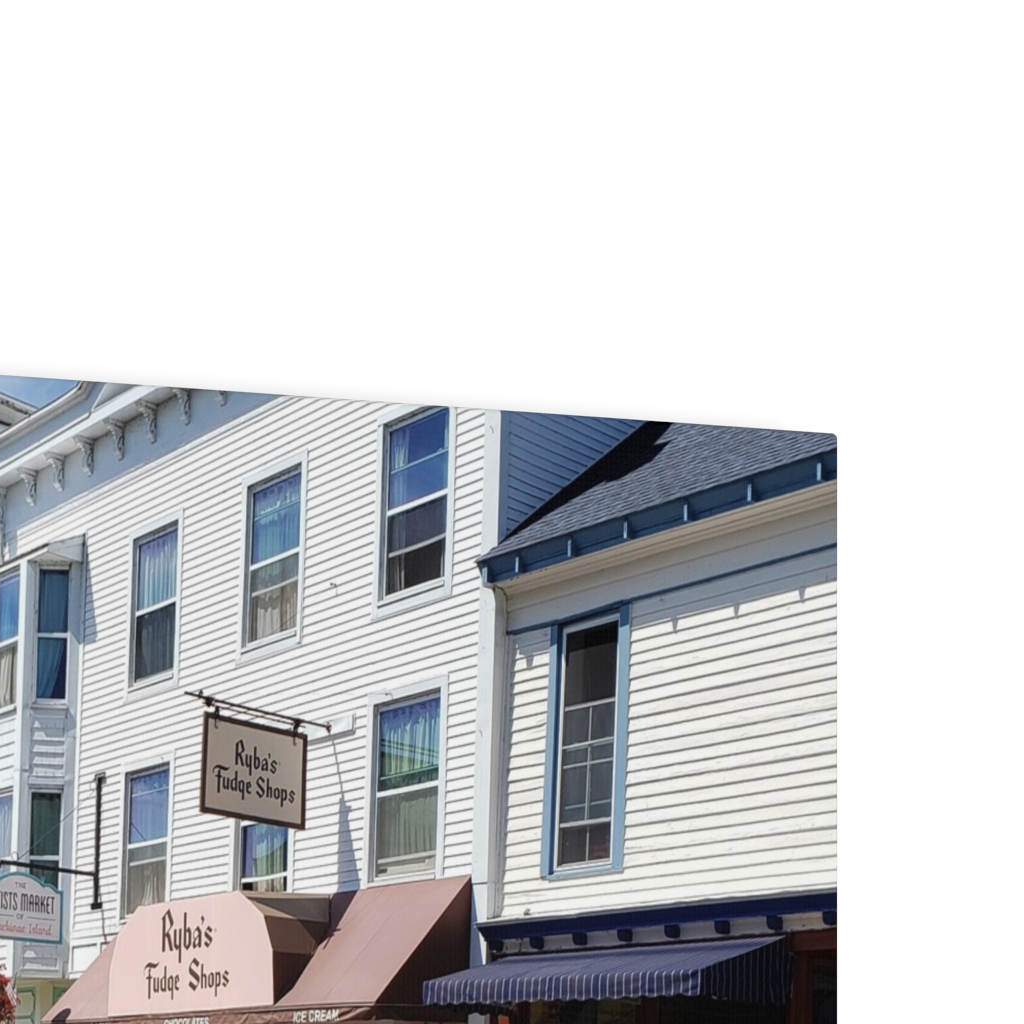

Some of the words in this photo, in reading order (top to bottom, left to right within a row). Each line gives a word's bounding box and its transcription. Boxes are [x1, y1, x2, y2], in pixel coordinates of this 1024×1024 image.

[235, 738, 278, 777] Ryba's
[212, 764, 252, 801] Fudge
[255, 775, 296, 808] Shops
[14, 881, 27, 889] THE
[20, 892, 55, 914] MARKET
[28, 923, 52, 936] Island
[161, 908, 213, 964] Ryba's
[143, 960, 180, 1001] Fudge
[188, 956, 230, 998] Shops
[293, 1011, 307, 1023] ICE
[308, 1009, 339, 1023] CREAM
